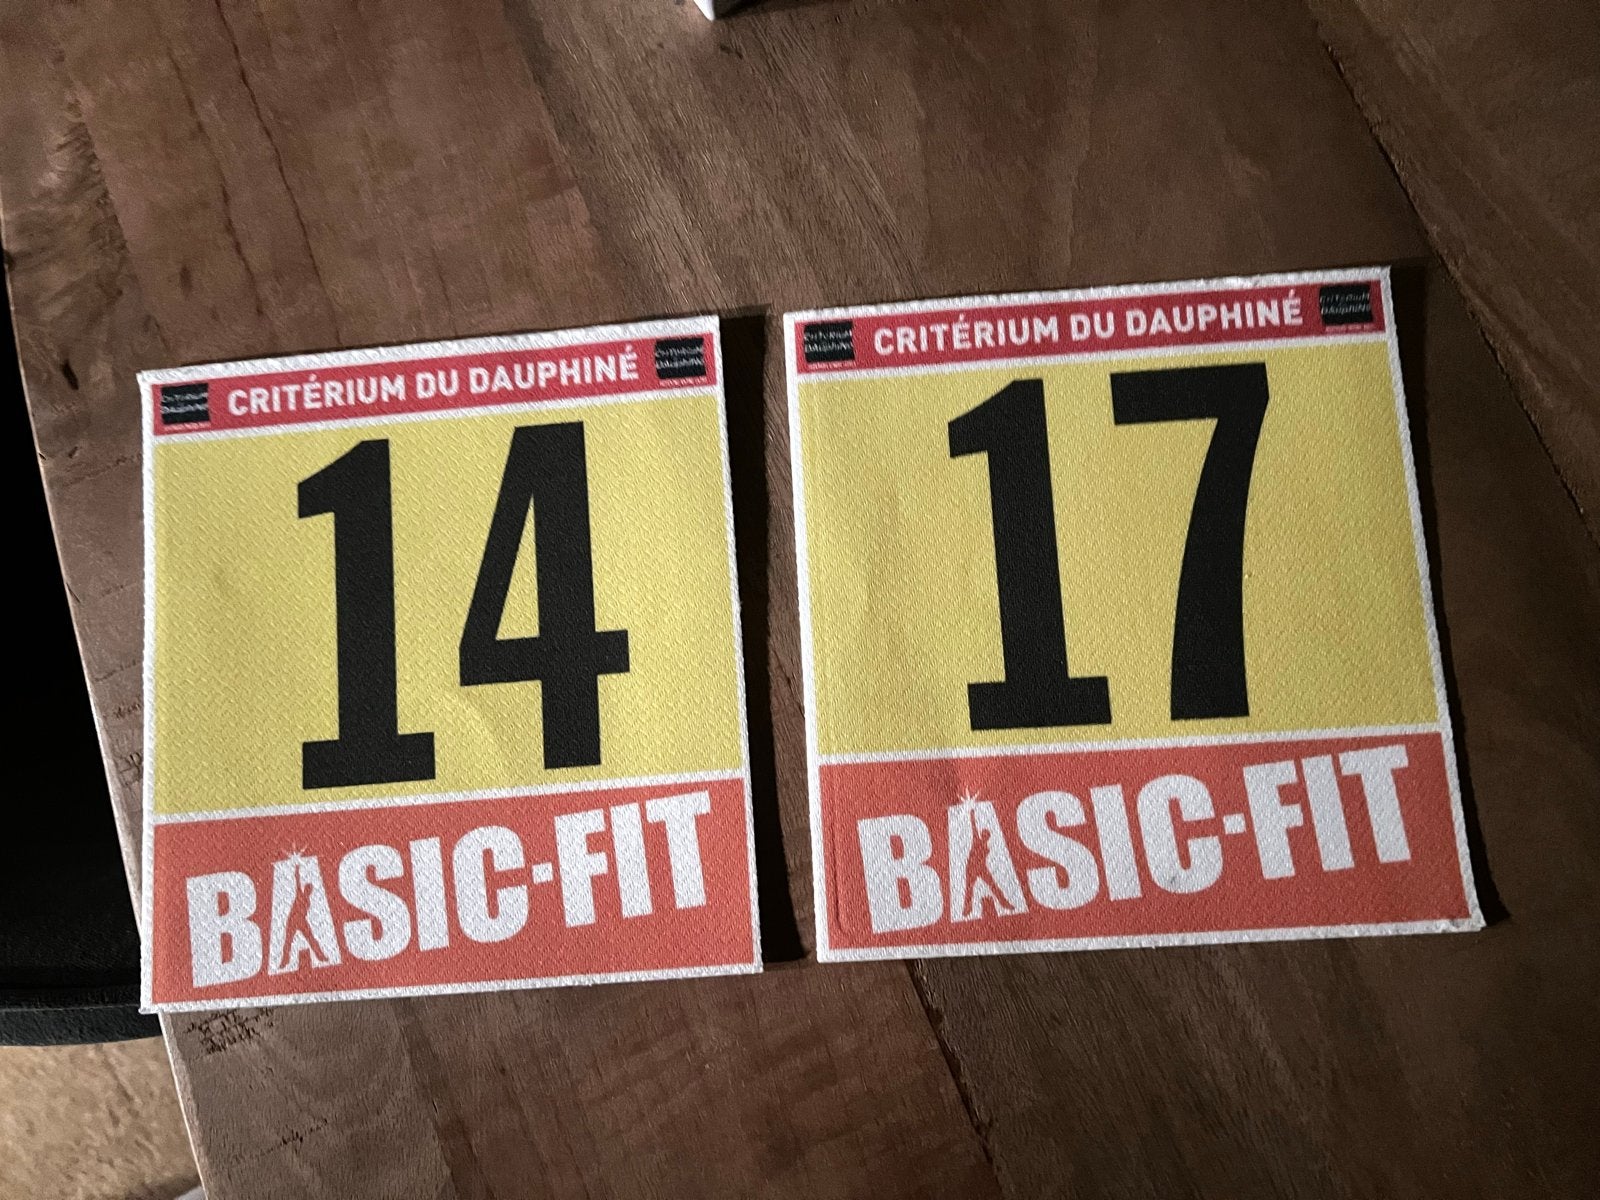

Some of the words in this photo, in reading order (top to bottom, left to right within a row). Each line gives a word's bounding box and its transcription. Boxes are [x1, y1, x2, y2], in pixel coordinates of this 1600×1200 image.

[228, 374, 406, 417] CRITÉRIUM
[416, 369, 461, 400] DU
[469, 345, 640, 395] DAUPHINÉ
[874, 313, 1061, 357] CRITÉRIUM
[1070, 312, 1116, 342] DU
[1126, 288, 1304, 338] DAUPHINÉ
[297, 421, 631, 790] 14
[948, 362, 1270, 732] 17
